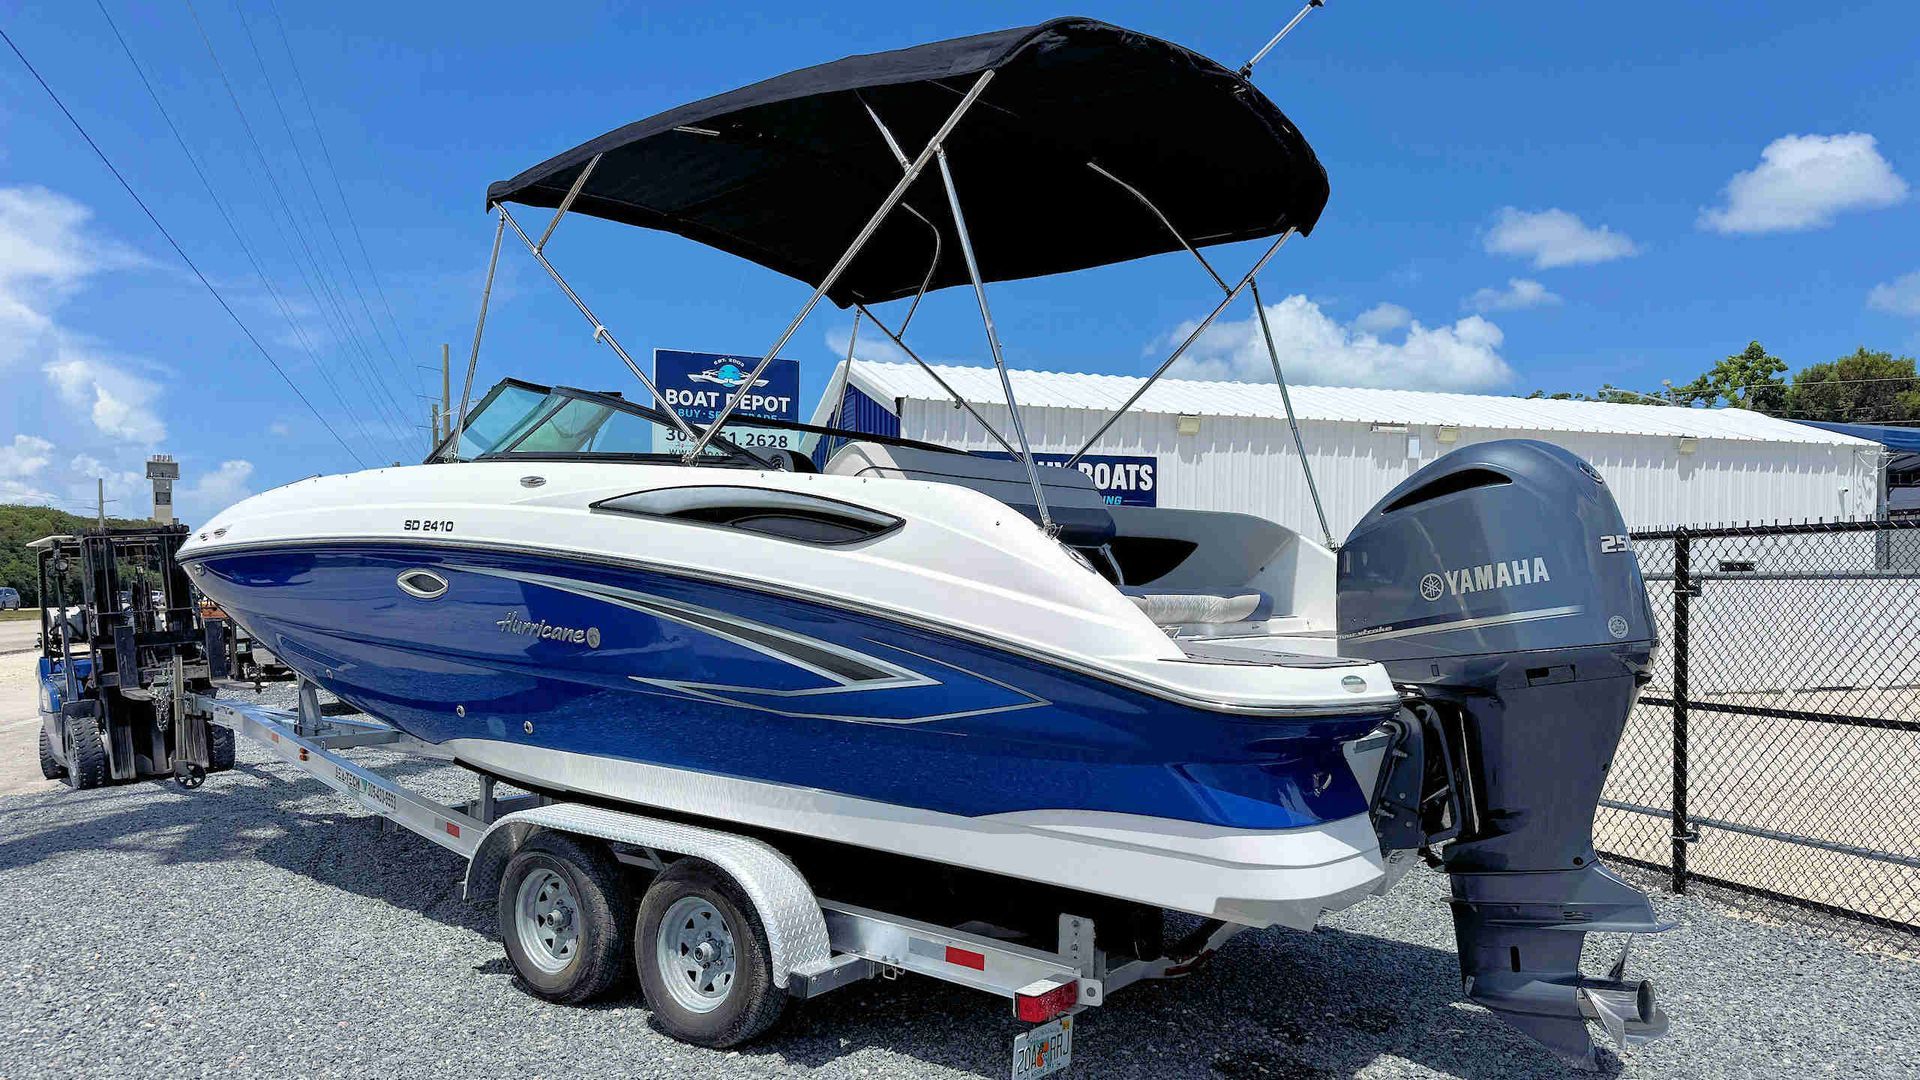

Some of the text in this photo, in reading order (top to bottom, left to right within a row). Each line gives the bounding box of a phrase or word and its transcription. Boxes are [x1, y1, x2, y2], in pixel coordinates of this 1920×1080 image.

[665, 388, 720, 408] BOAT
[678, 408, 701, 418] BUY
[404, 519, 454, 532] SD 2410
[1444, 557, 1551, 596] YAMAHA
[496, 610, 586, 644] Hurricane
